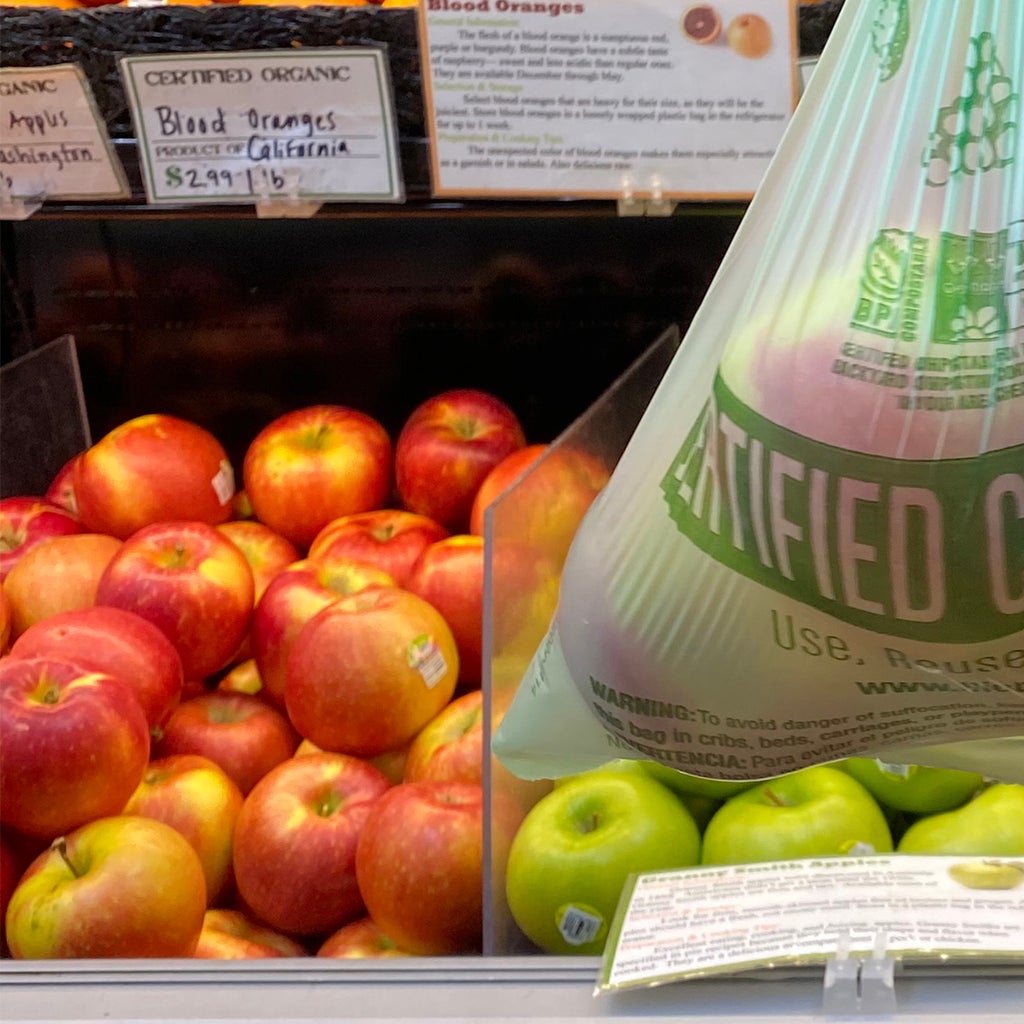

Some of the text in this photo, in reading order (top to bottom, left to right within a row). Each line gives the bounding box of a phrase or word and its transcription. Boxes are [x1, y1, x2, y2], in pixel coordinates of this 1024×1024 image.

[145, 66, 351, 86] CERTIFIED ORGANIC
[9, 110, 68, 136] Apples
[156, 105, 336, 137] Blood Oranges
[156, 144, 221, 158] PRODUCT
[248, 134, 350, 162] California
[771, 609, 865, 666] Use,
[590, 675, 696, 722] WARNING:
[697, 709, 720, 726] To
[726, 718, 777, 731] avoid
[783, 715, 849, 731] danger
[855, 711, 875, 723] of
[629, 721, 666, 745] bag
[673, 728, 692, 743] in
[924, 713, 943, 722] or
[752, 754, 796, 769] Para
[801, 740, 853, 761] evitar
